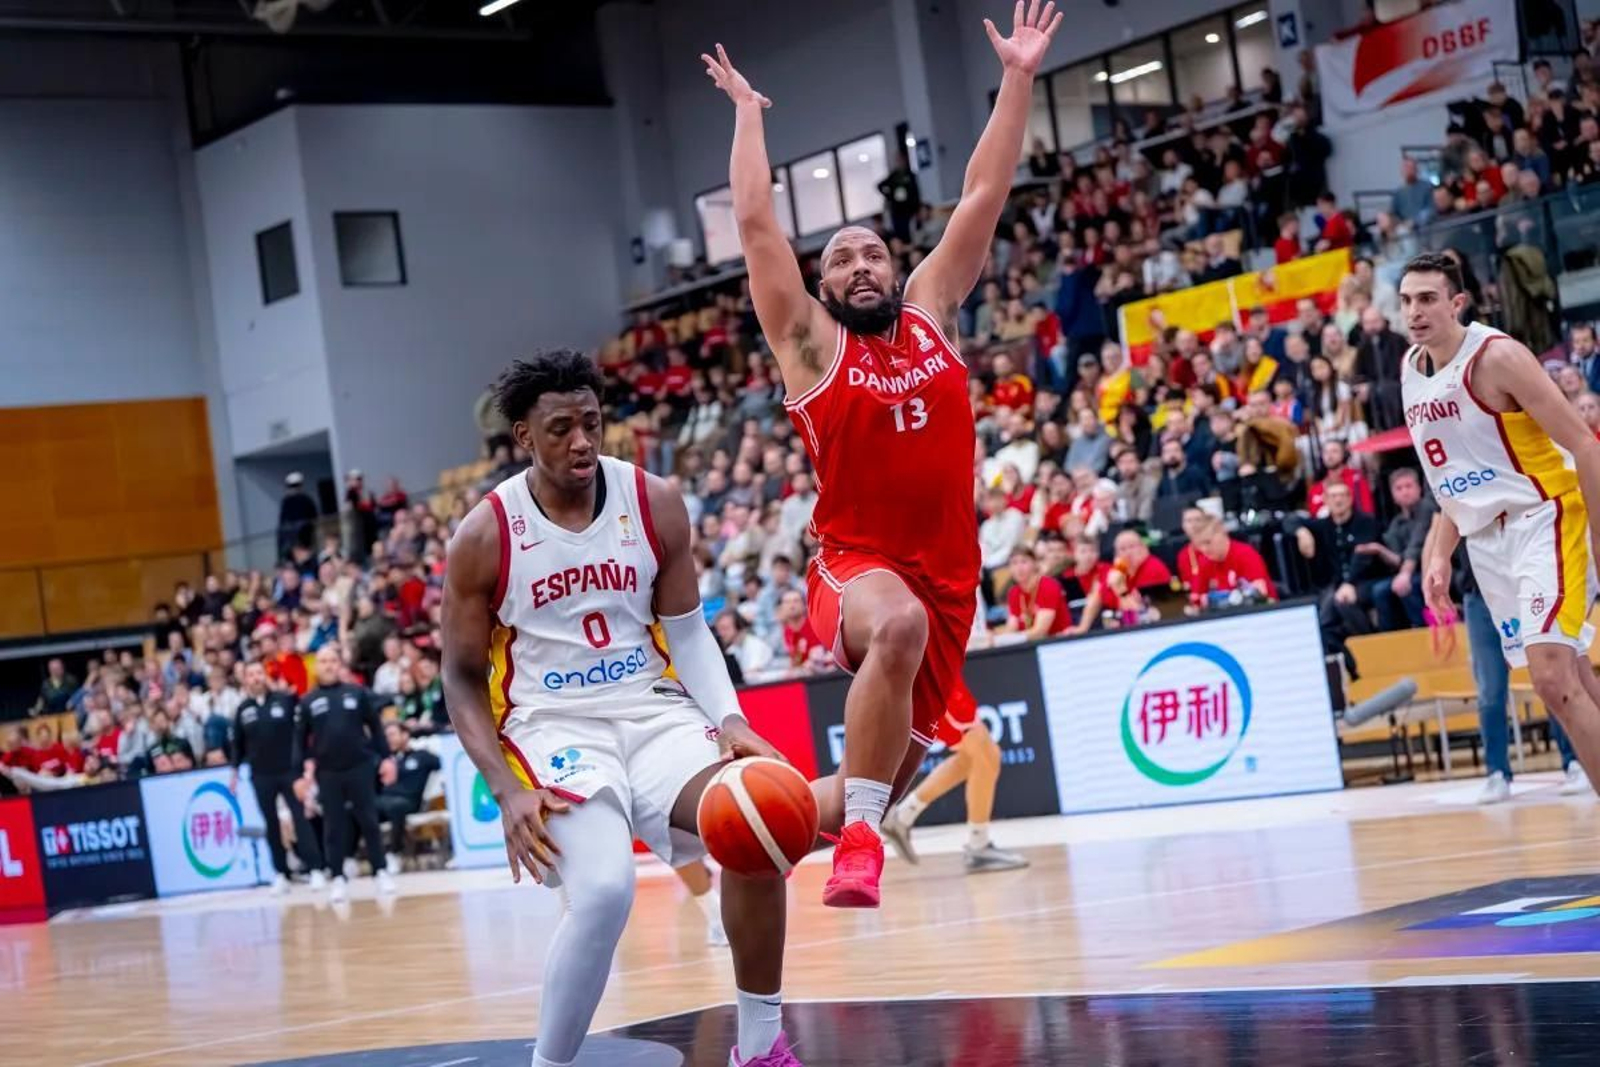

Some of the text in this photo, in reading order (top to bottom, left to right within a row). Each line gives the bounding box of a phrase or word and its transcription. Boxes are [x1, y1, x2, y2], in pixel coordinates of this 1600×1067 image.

[1421, 17, 1492, 59] DBBF
[848, 351, 949, 394] DANMARK
[889, 397, 928, 433] 13
[1406, 398, 1461, 428] SPAÑA
[1424, 438, 1448, 467] 8
[1437, 468, 1496, 497] desa
[531, 558, 637, 609] ESPAÑA
[582, 611, 611, 648] 0
[543, 646, 648, 690] endesa
[1139, 682, 1228, 745] 伊利
[0, 829, 24, 878] L
[67, 815, 140, 854] TISSOT
